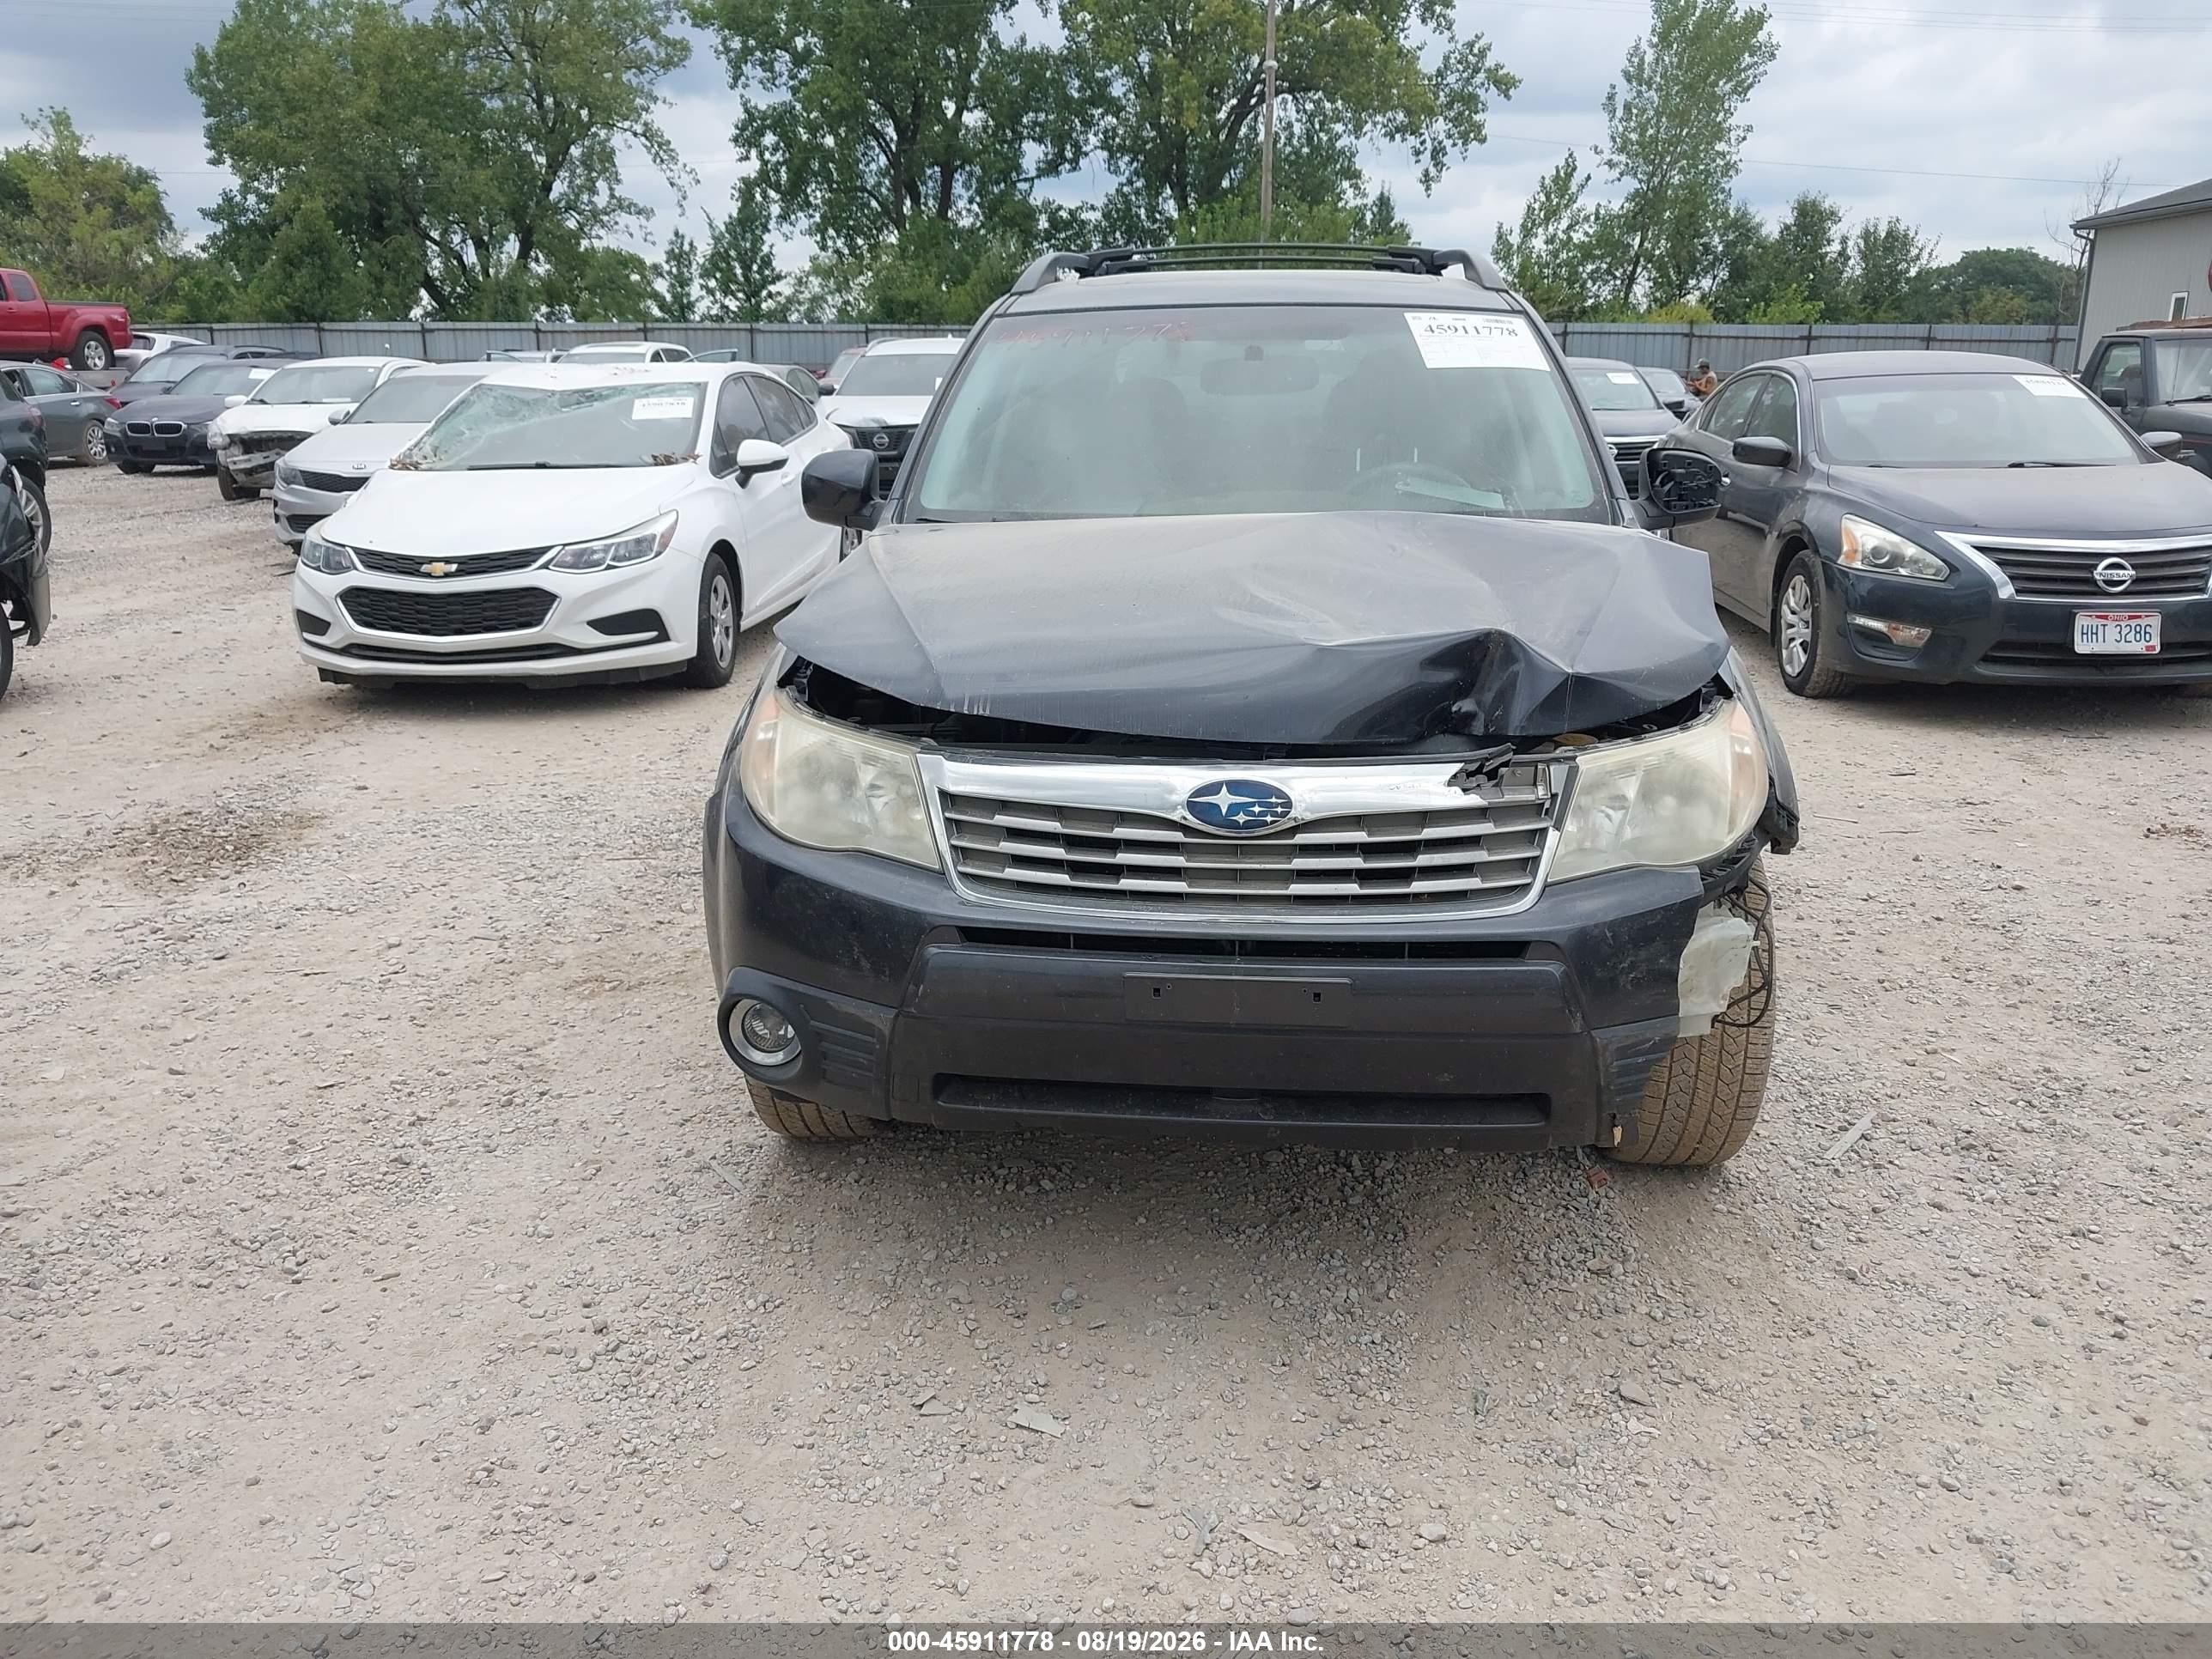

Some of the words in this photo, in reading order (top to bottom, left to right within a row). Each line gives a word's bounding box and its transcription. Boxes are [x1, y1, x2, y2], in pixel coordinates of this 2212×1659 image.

[1424, 324, 1519, 337] 45911778
[2081, 623, 2109, 643] HHT
[2114, 623, 2153, 643] 3286
